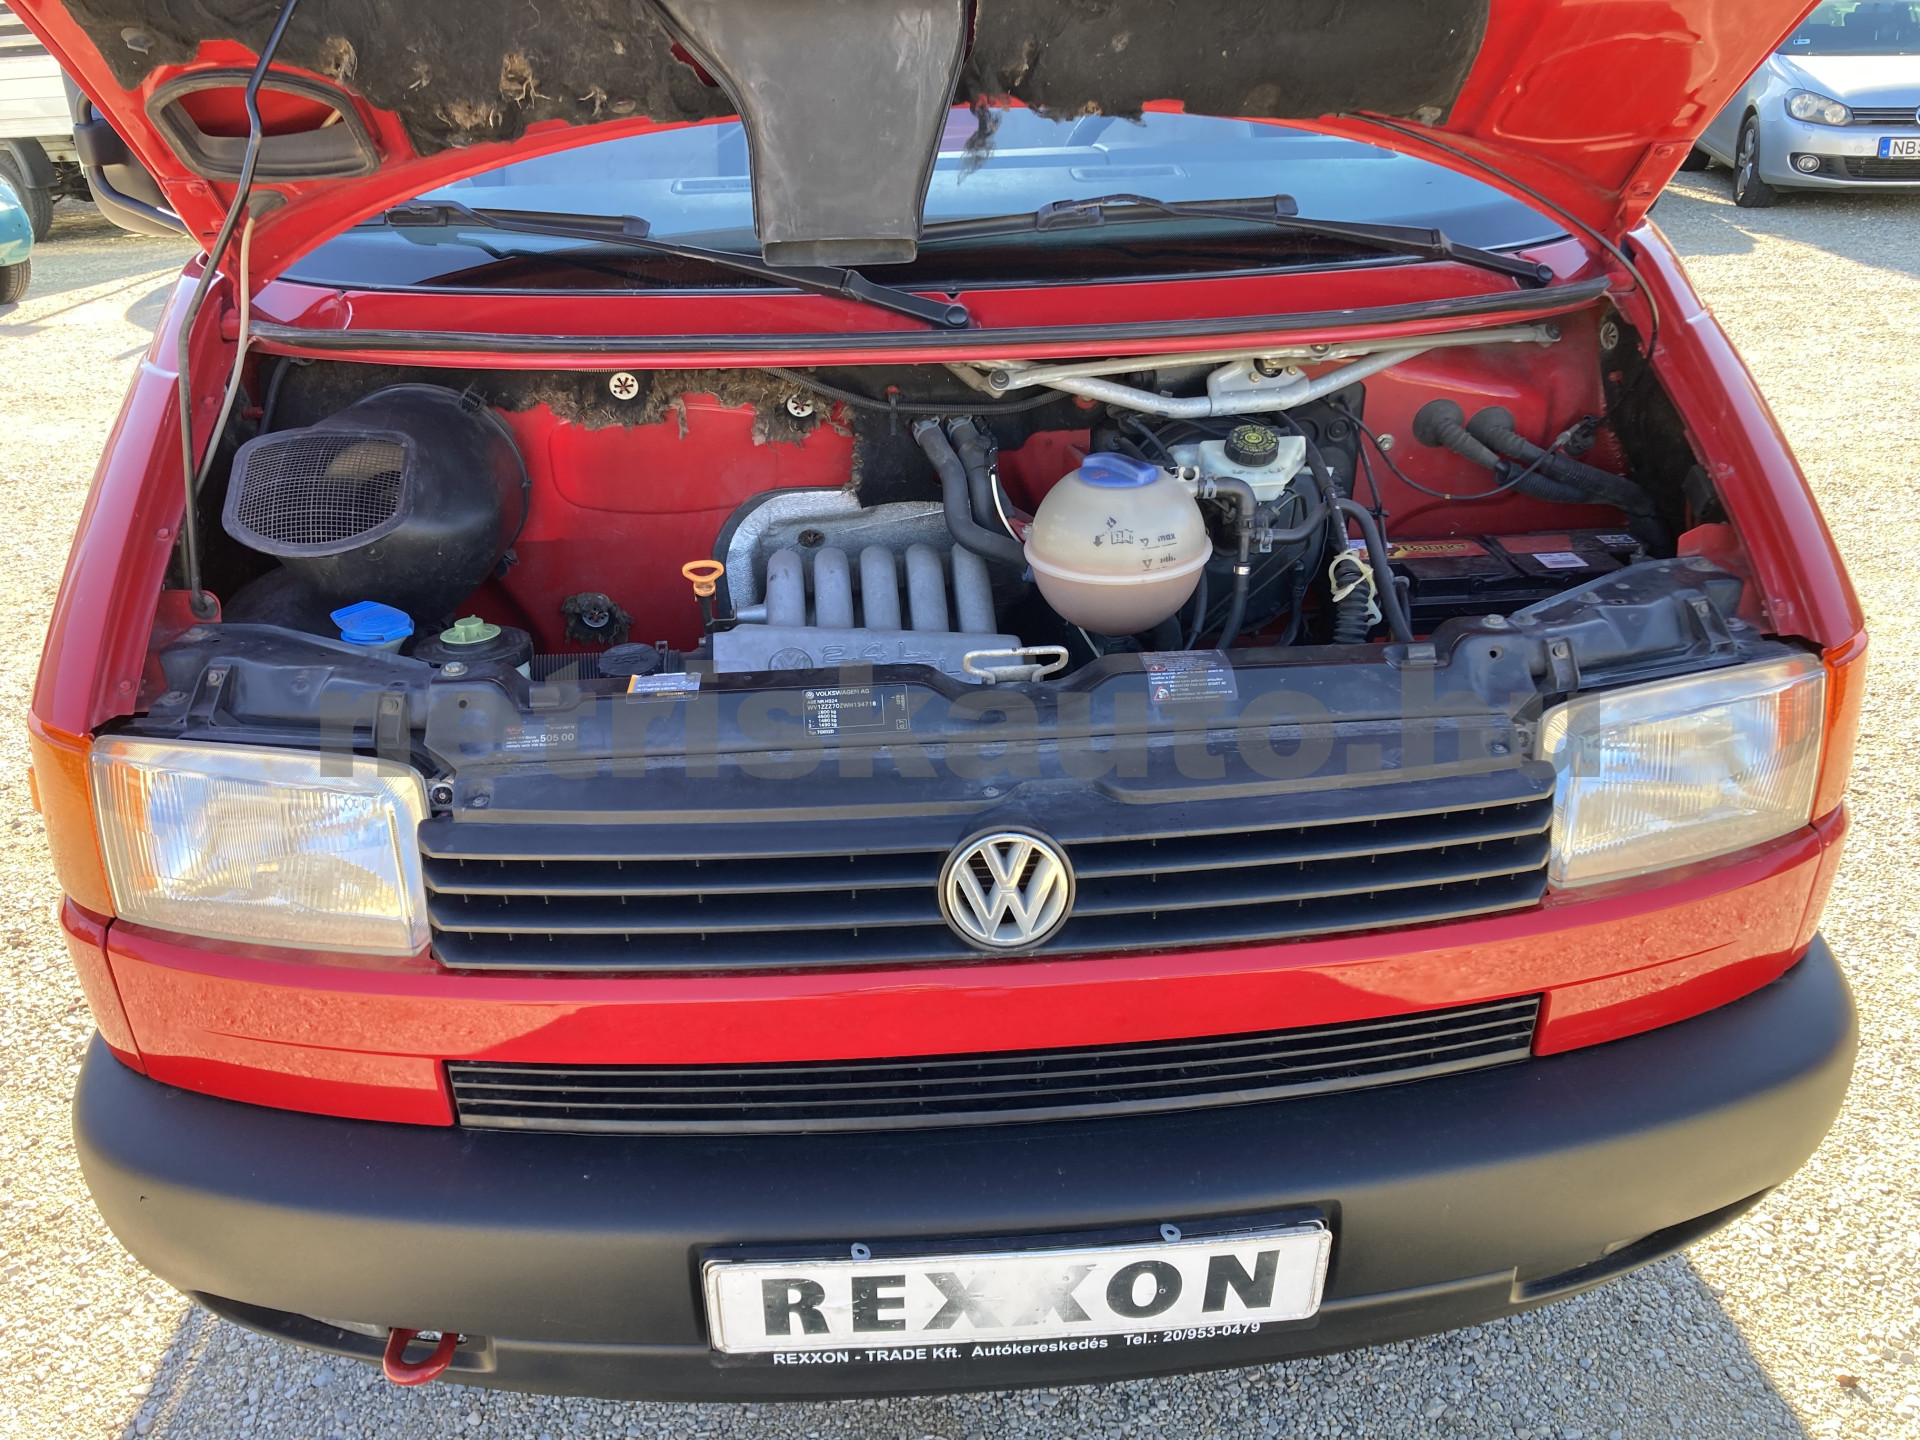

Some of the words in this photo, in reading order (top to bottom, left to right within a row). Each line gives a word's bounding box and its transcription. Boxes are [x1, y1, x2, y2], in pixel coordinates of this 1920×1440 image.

[1893, 141, 1920, 154] NB
[1157, 533, 1176, 542] max
[815, 689, 860, 697] VOLKSWAGEN
[540, 733, 559, 742] 505
[561, 733, 575, 741] 00
[761, 1250, 1281, 1336] REXXON
[773, 1351, 849, 1365] REXXON
[864, 1348, 927, 1362] TRADE
[932, 1347, 962, 1360] Kft.
[971, 1336, 1109, 1357] Autókereskedés
[1123, 1332, 1158, 1346] Tel.:
[1163, 1322, 1261, 1343] 20/953-0479
